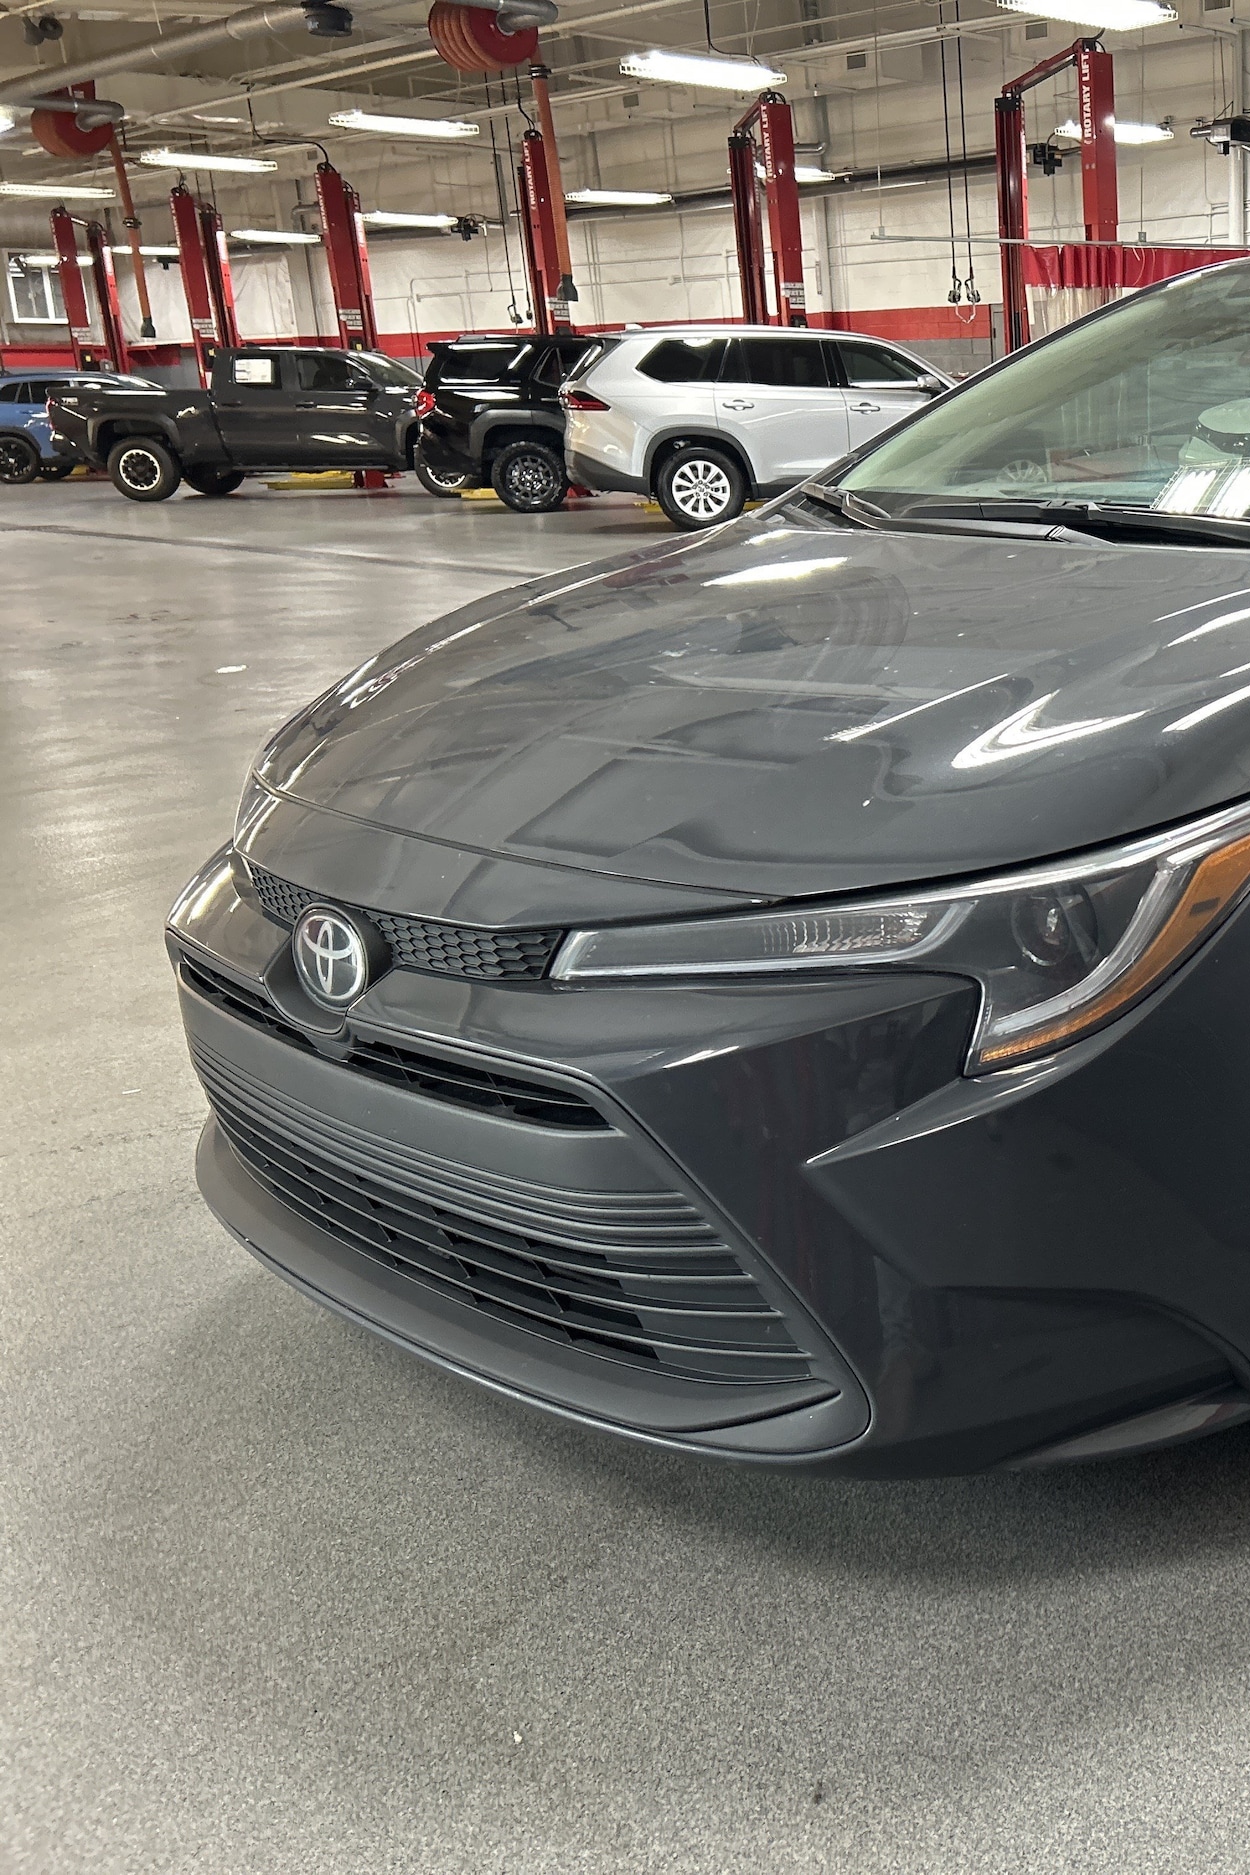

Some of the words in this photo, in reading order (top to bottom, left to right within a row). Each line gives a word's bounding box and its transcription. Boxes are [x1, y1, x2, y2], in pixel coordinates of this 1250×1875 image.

[1081, 53, 1090, 82] LIFT
[761, 104, 769, 129] LIFT
[1082, 85, 1092, 138] ROTARY
[523, 141, 531, 162] LIFT
[763, 132, 773, 177] ROTARY
[526, 165, 536, 205] ROTARY
